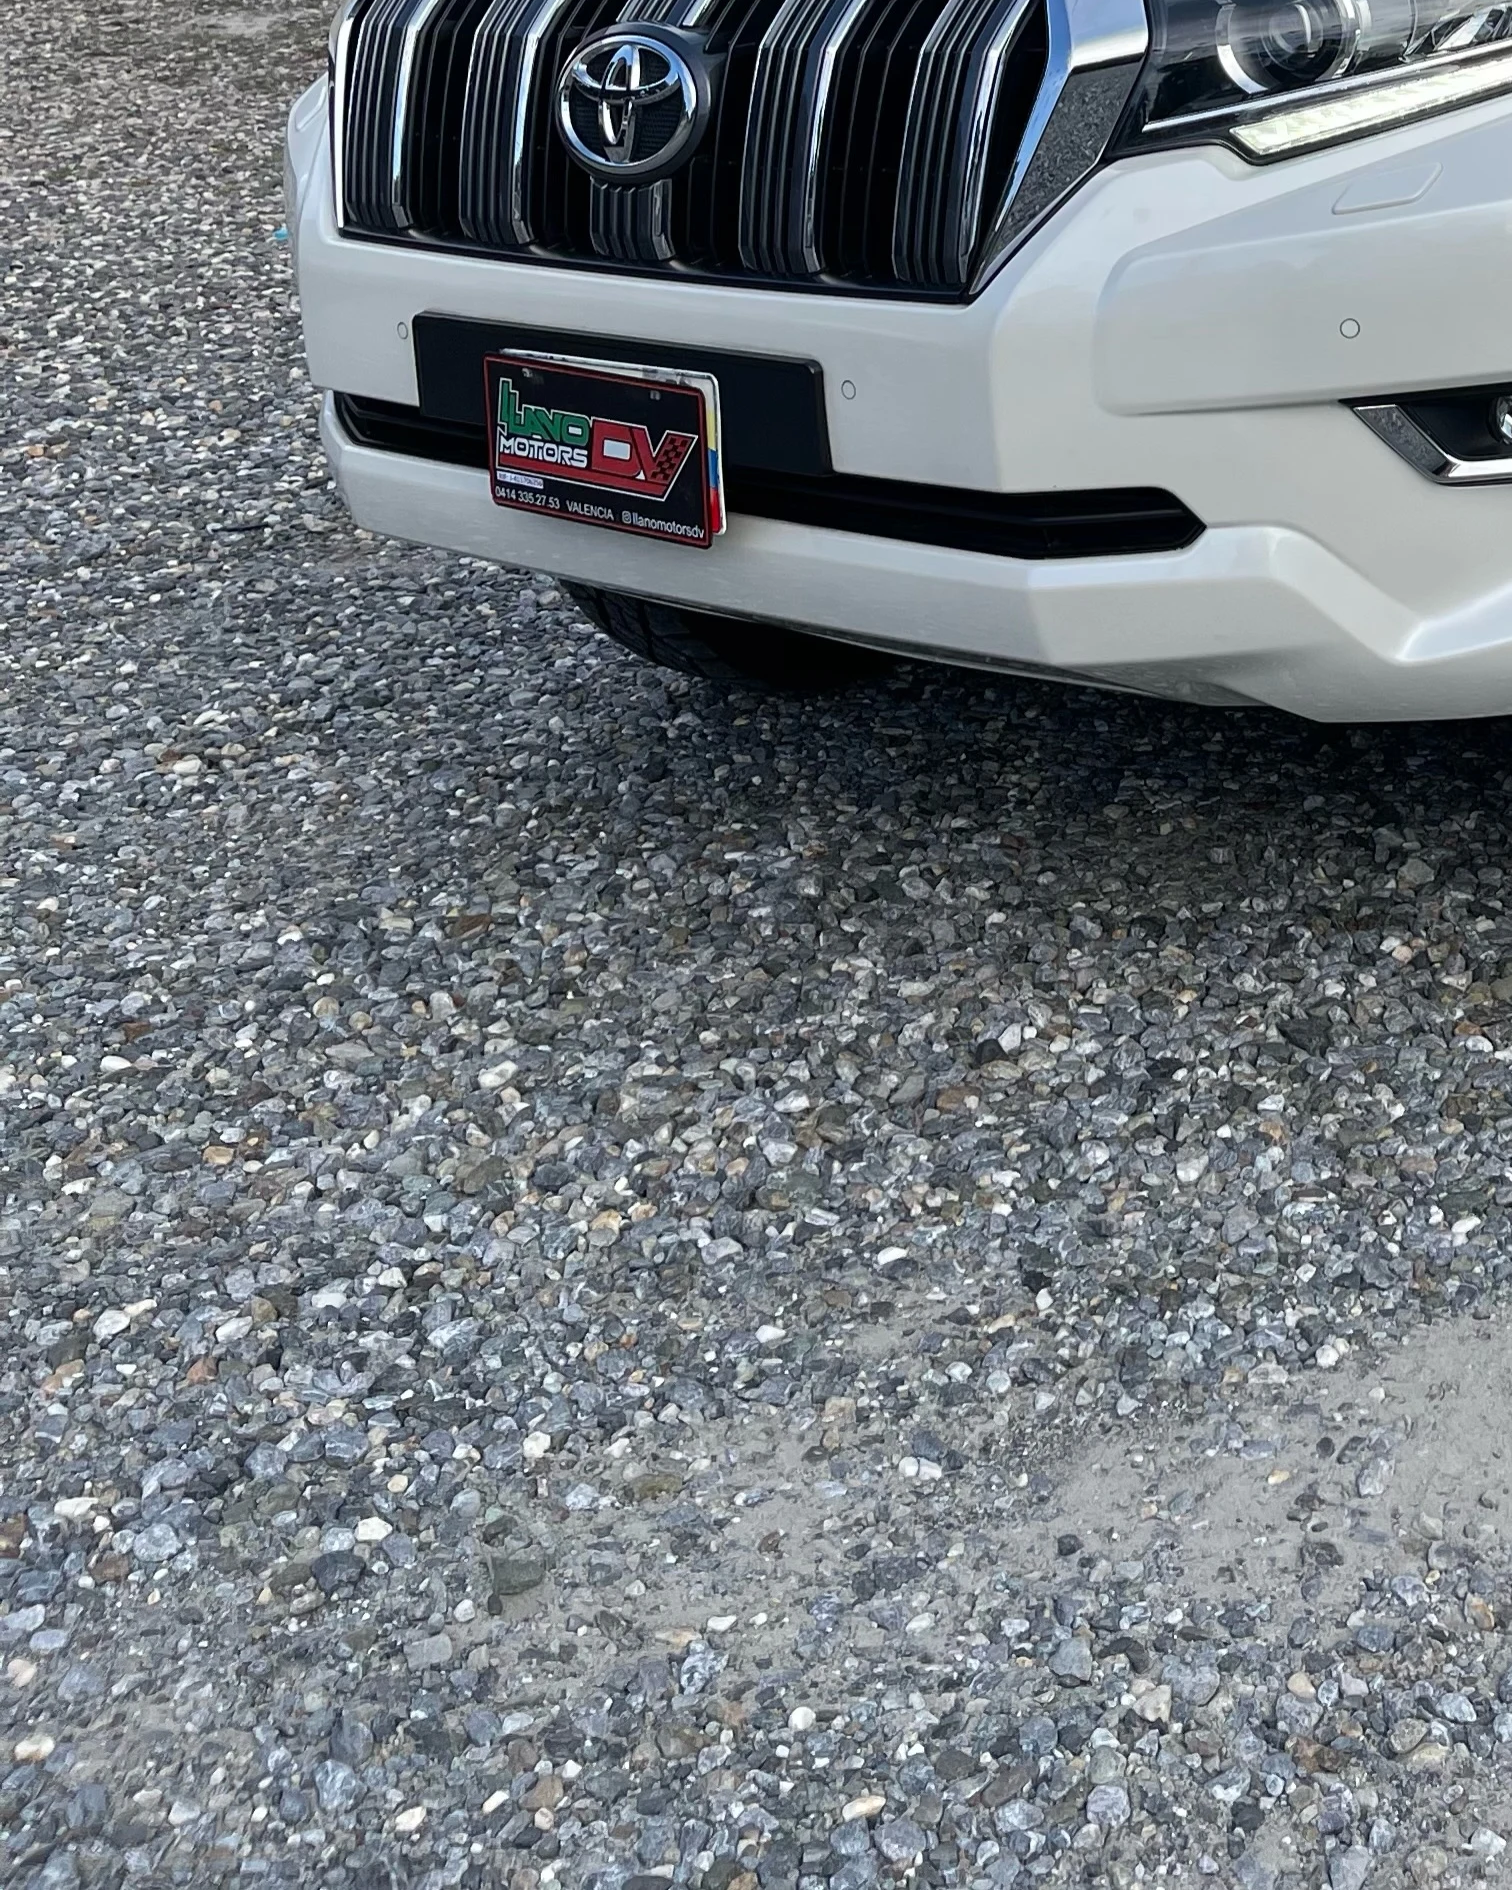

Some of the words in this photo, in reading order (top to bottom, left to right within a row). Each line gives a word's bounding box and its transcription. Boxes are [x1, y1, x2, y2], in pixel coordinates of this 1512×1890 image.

[499, 378, 590, 447] LLANO
[499, 435, 588, 469] MOTORS
[590, 416, 699, 485] DV
[494, 485, 517, 500] 0414
[566, 500, 615, 521] VALENCIA
